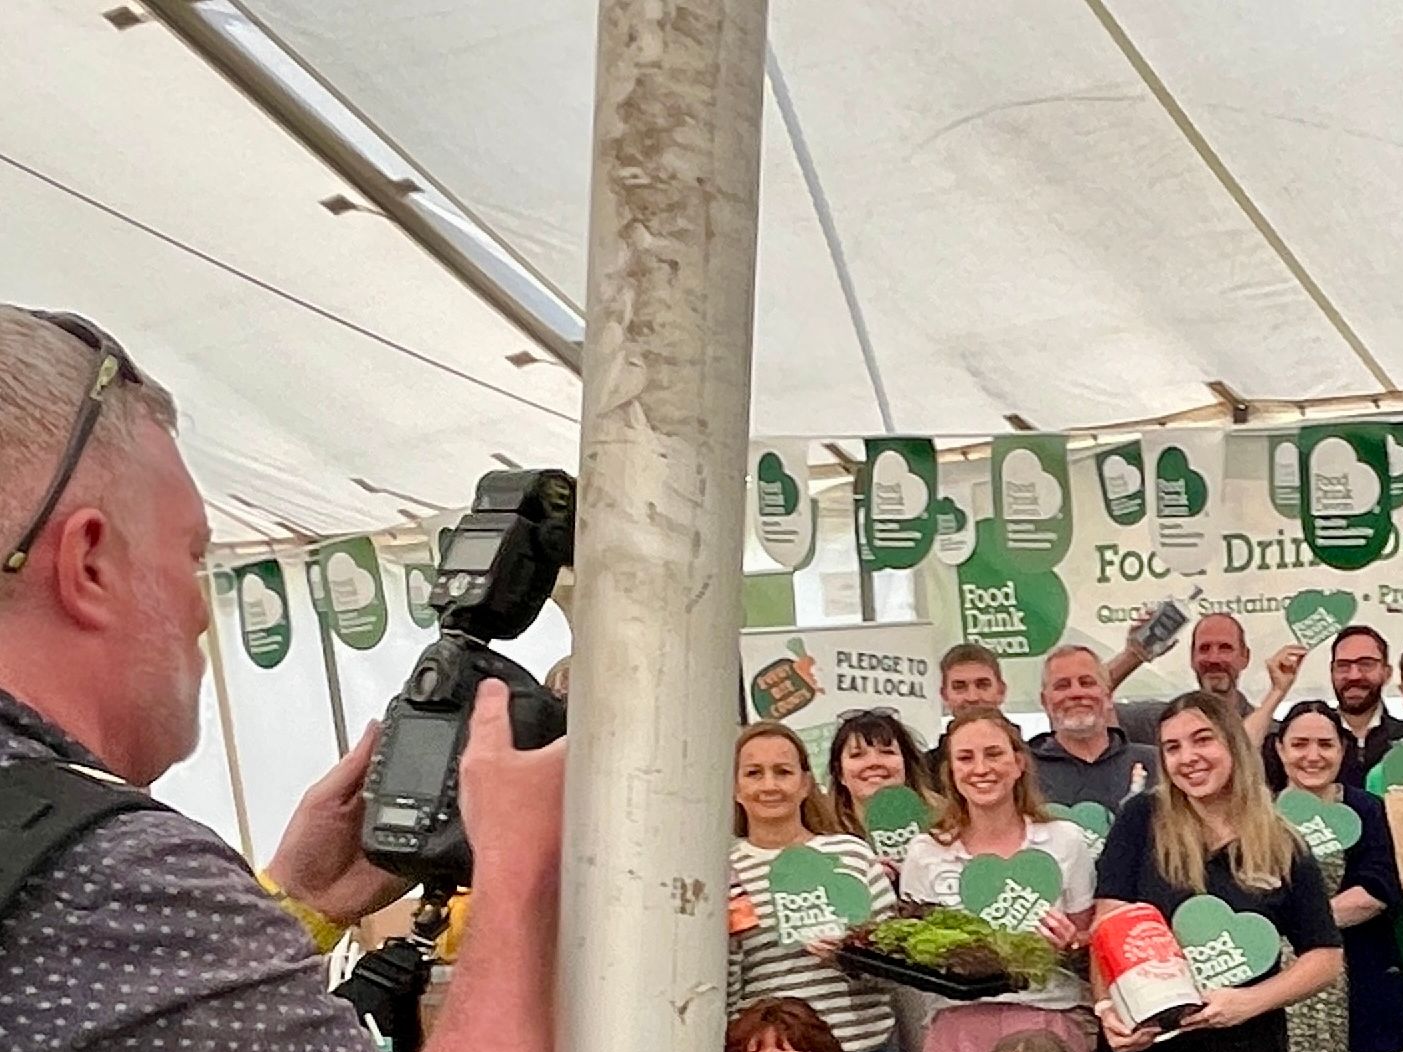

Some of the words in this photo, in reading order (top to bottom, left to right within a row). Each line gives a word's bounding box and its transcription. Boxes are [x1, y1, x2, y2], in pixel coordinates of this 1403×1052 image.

[962, 581, 1018, 608] Food
[965, 606, 1028, 633] Drink
[836, 650, 906, 673] PLEDGE
[907, 657, 928, 676] TO
[836, 674, 868, 693] EAT
[873, 677, 928, 699] LOCAL
[871, 821, 920, 850] Food
[774, 886, 828, 910] Food
[980, 878, 1022, 922] Food
[777, 903, 838, 928] Drink
[1183, 930, 1236, 961] Food
[1191, 948, 1248, 980] Drink
